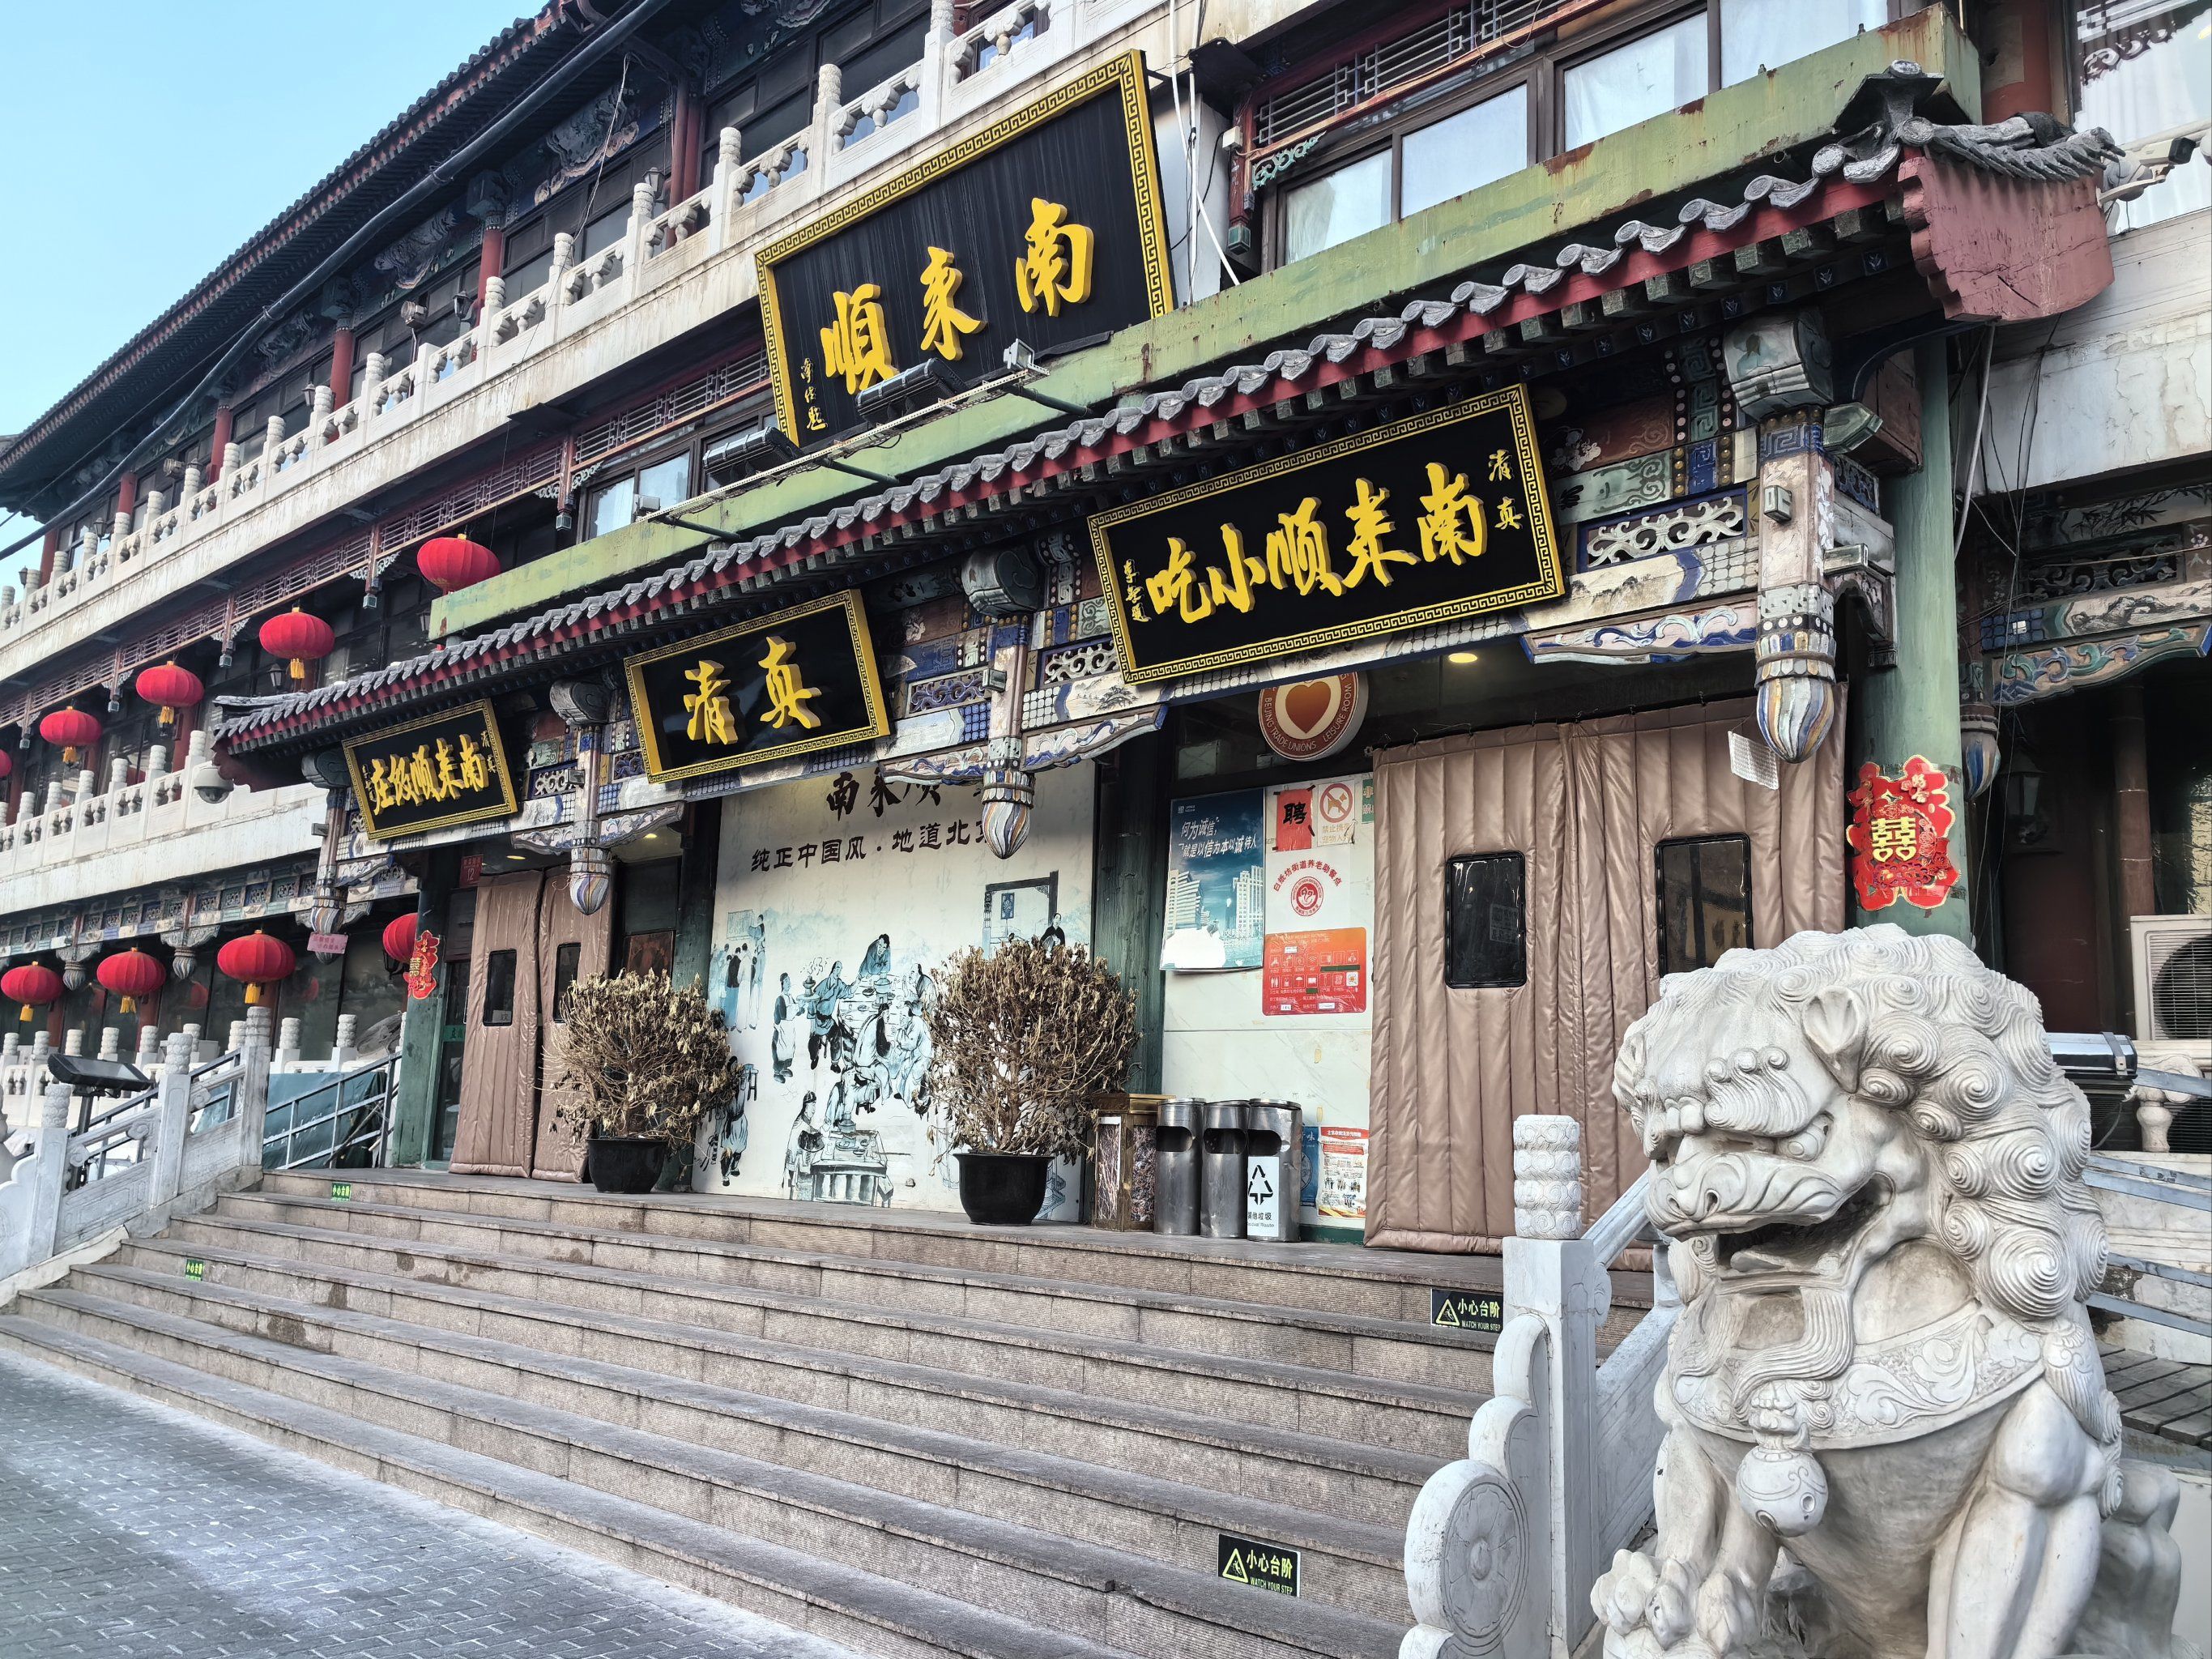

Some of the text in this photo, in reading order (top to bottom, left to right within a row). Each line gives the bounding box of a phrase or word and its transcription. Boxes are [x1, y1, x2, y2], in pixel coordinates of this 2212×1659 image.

[1489, 449, 1524, 530] 清真
[684, 636, 822, 745] 清真
[1264, 683, 1353, 752] BEIJING TRADE UNIONS LEISURE ROOM
[1282, 801, 1308, 825] 聘
[1457, 1298, 1500, 1319] 小心台阶
[1461, 1320, 1501, 1332] WATCH YOUR STEP
[1247, 1549, 1294, 1580] 小心台阶
[1250, 1576, 1293, 1595] WATCH YOUR STEP
